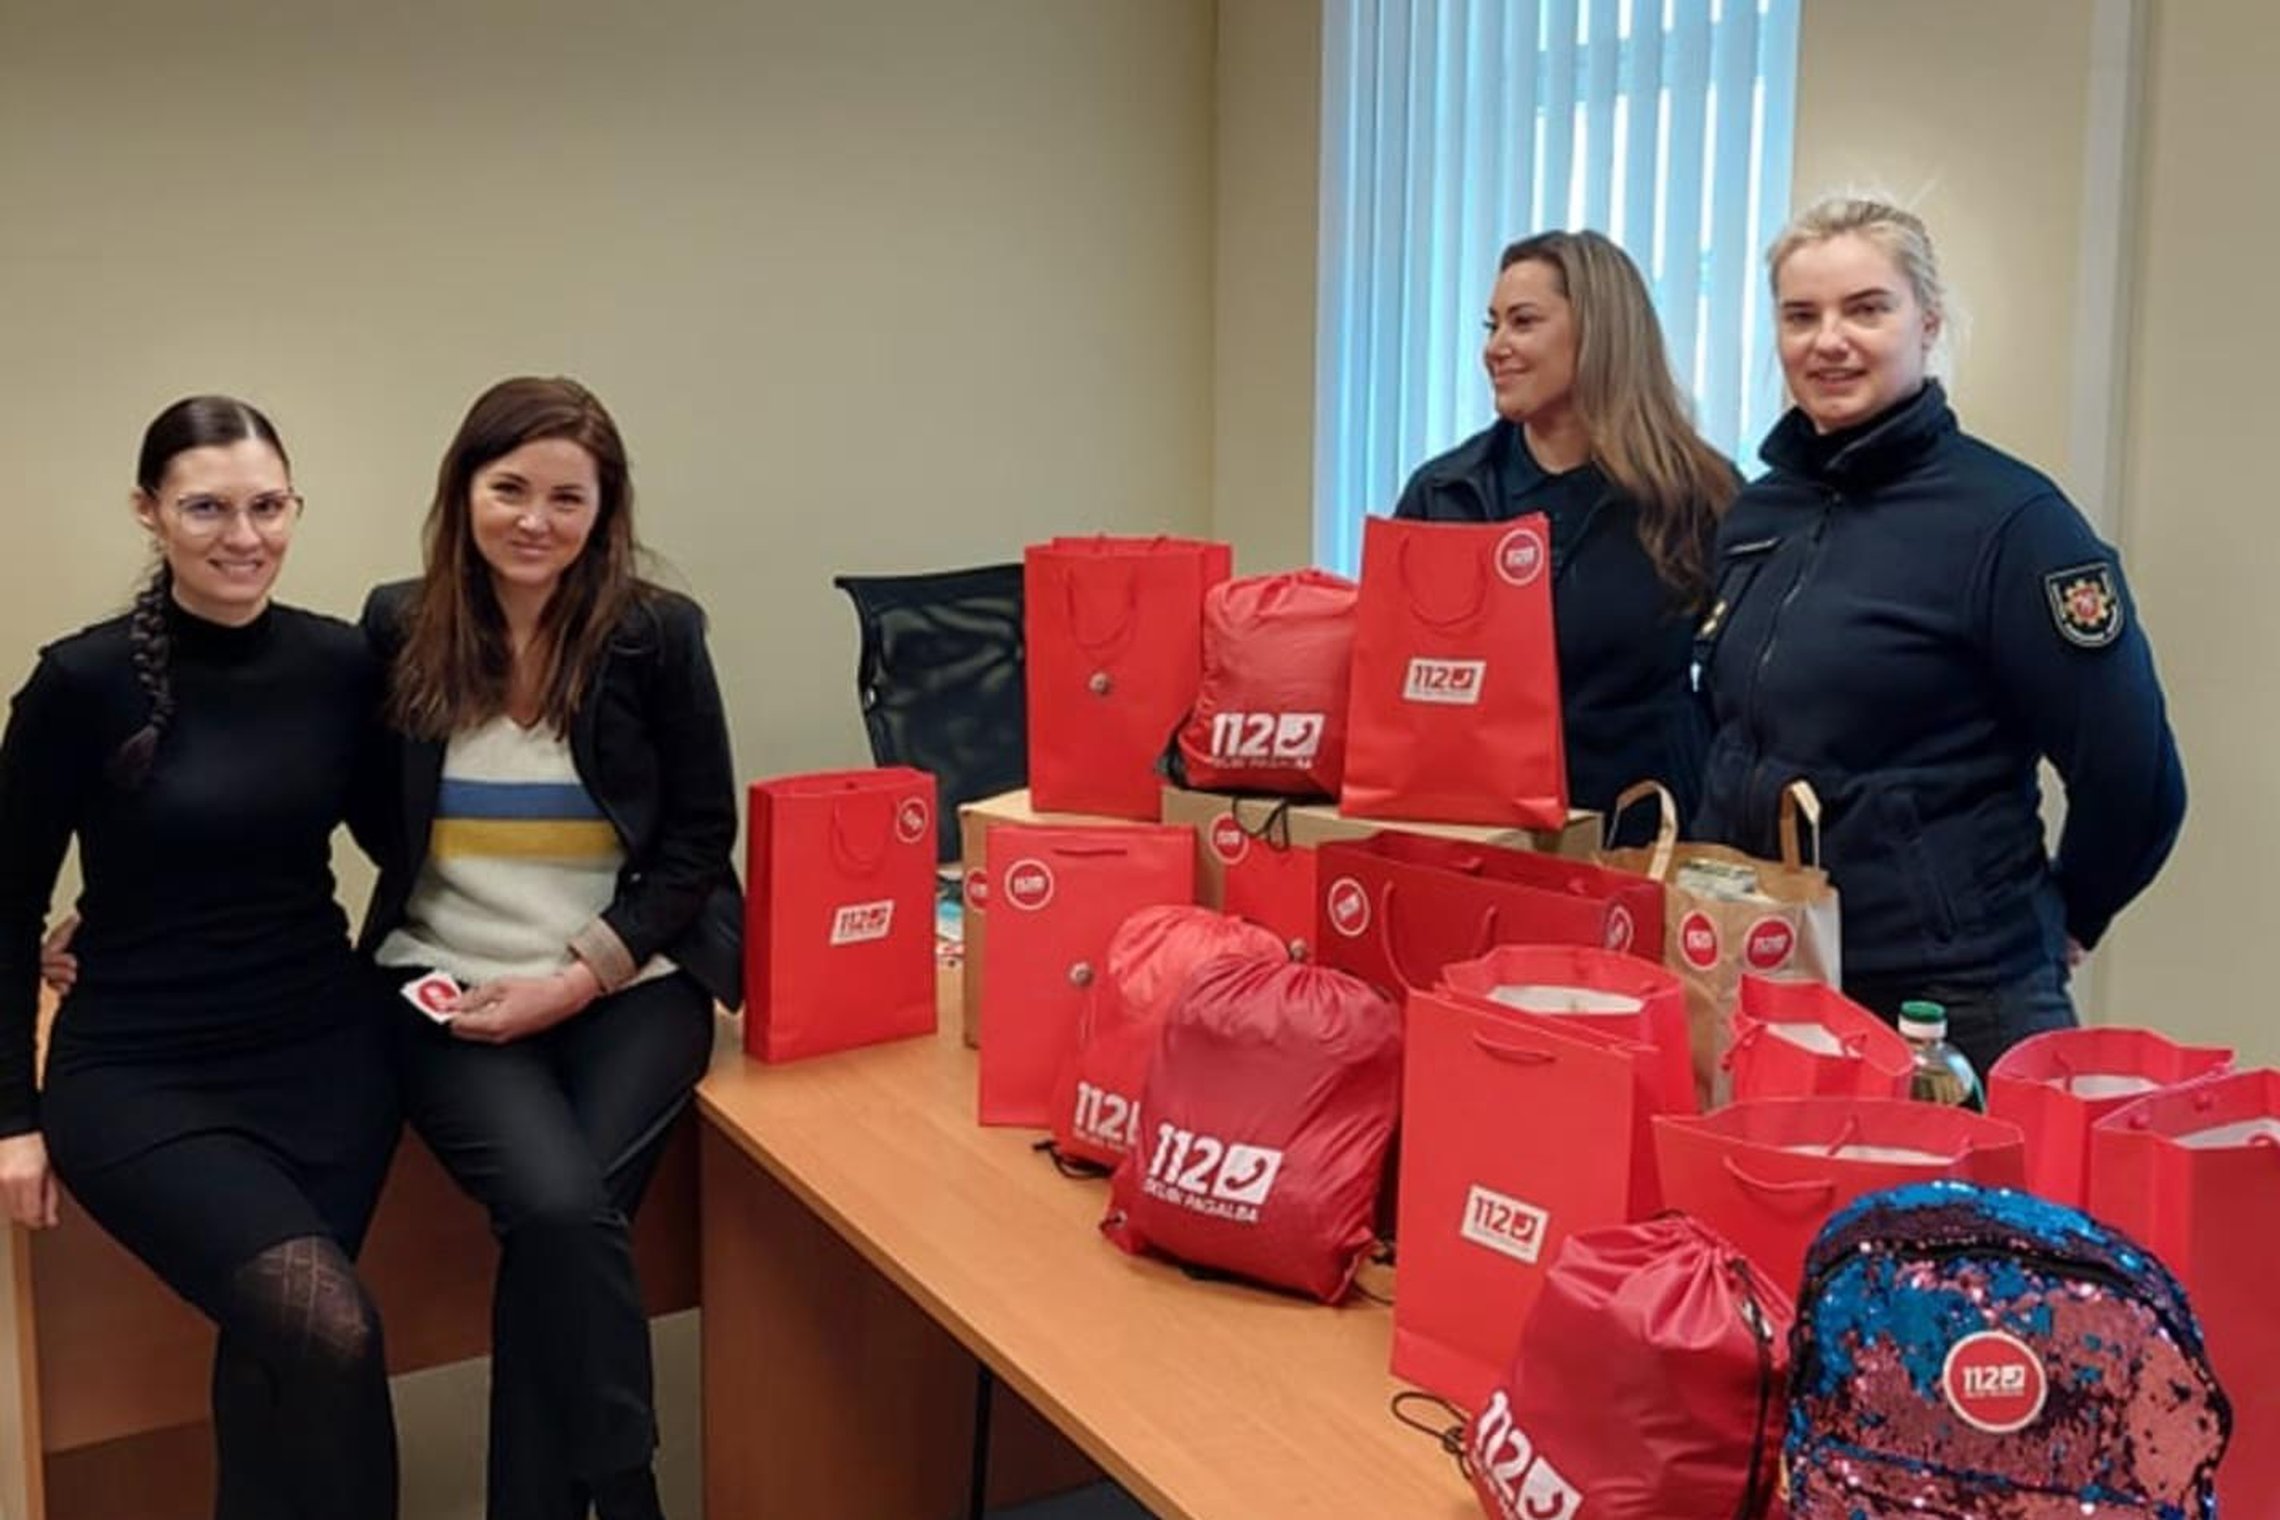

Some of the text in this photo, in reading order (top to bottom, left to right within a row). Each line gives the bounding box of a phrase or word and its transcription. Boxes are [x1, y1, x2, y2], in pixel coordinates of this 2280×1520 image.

[1414, 665, 1449, 689] 112
[1211, 712, 1275, 757] 112
[1074, 1082, 1128, 1140] 112
[1149, 1122, 1223, 1194] 112
[1474, 1195, 1511, 1233] 112
[1963, 1365, 2000, 1391] 112
[1475, 1391, 1532, 1502] 112
